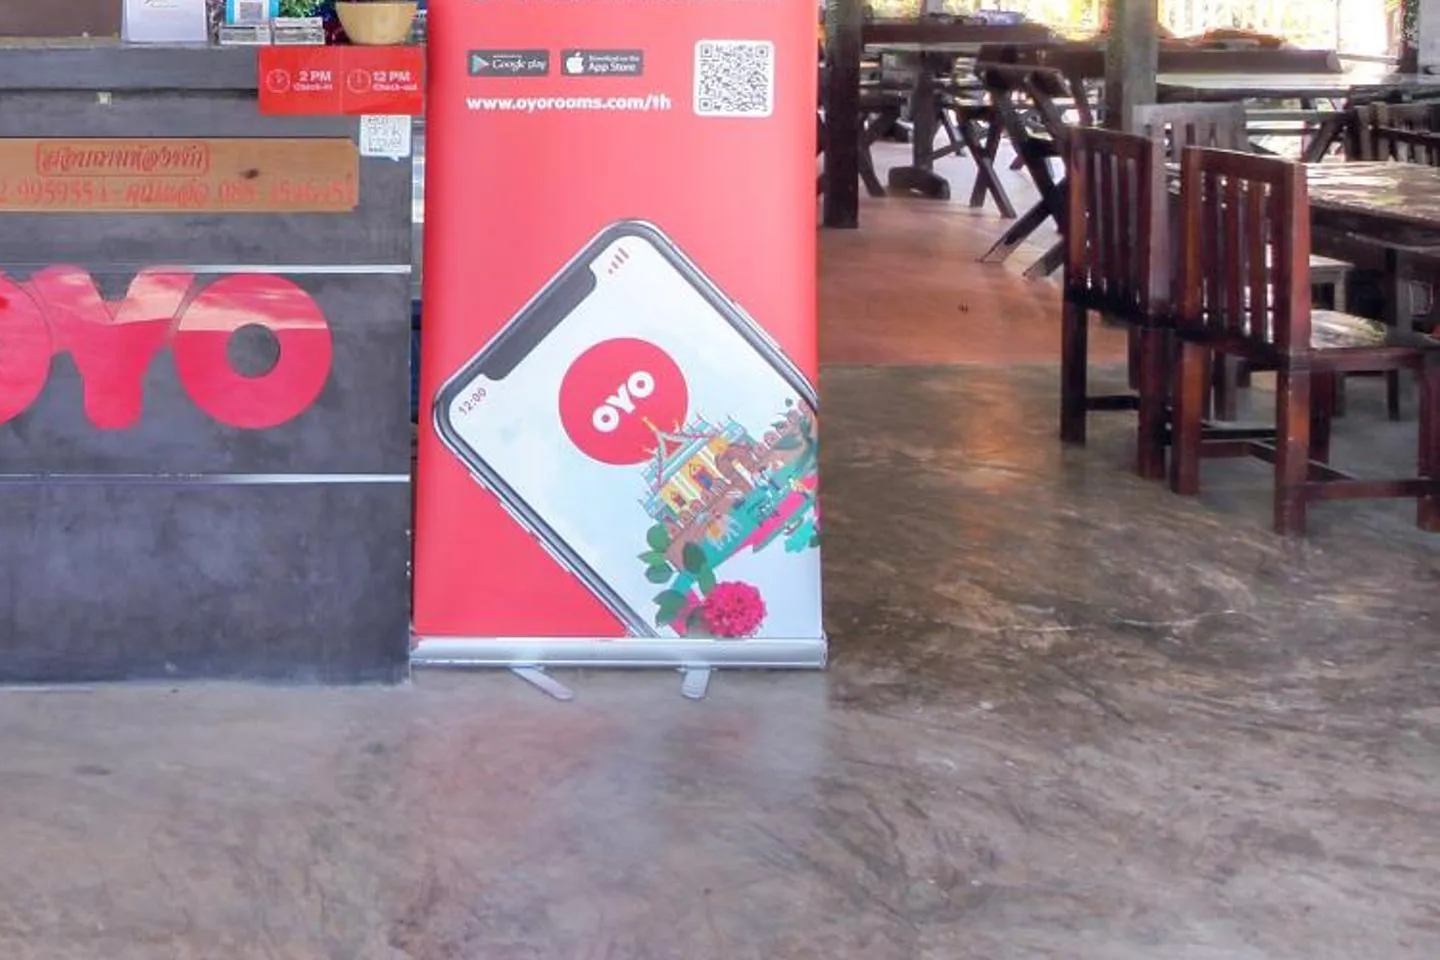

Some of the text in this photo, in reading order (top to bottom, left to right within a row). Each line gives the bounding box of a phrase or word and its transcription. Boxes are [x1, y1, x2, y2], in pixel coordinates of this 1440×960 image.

[492, 59, 526, 71] Google
[588, 61, 637, 73] App Store
[299, 71, 331, 81] 2 PM
[389, 71, 410, 81] PM
[466, 94, 672, 114] www.oyorooms.com/th
[458, 386, 488, 417] 12:00
[592, 370, 655, 433] OYO
